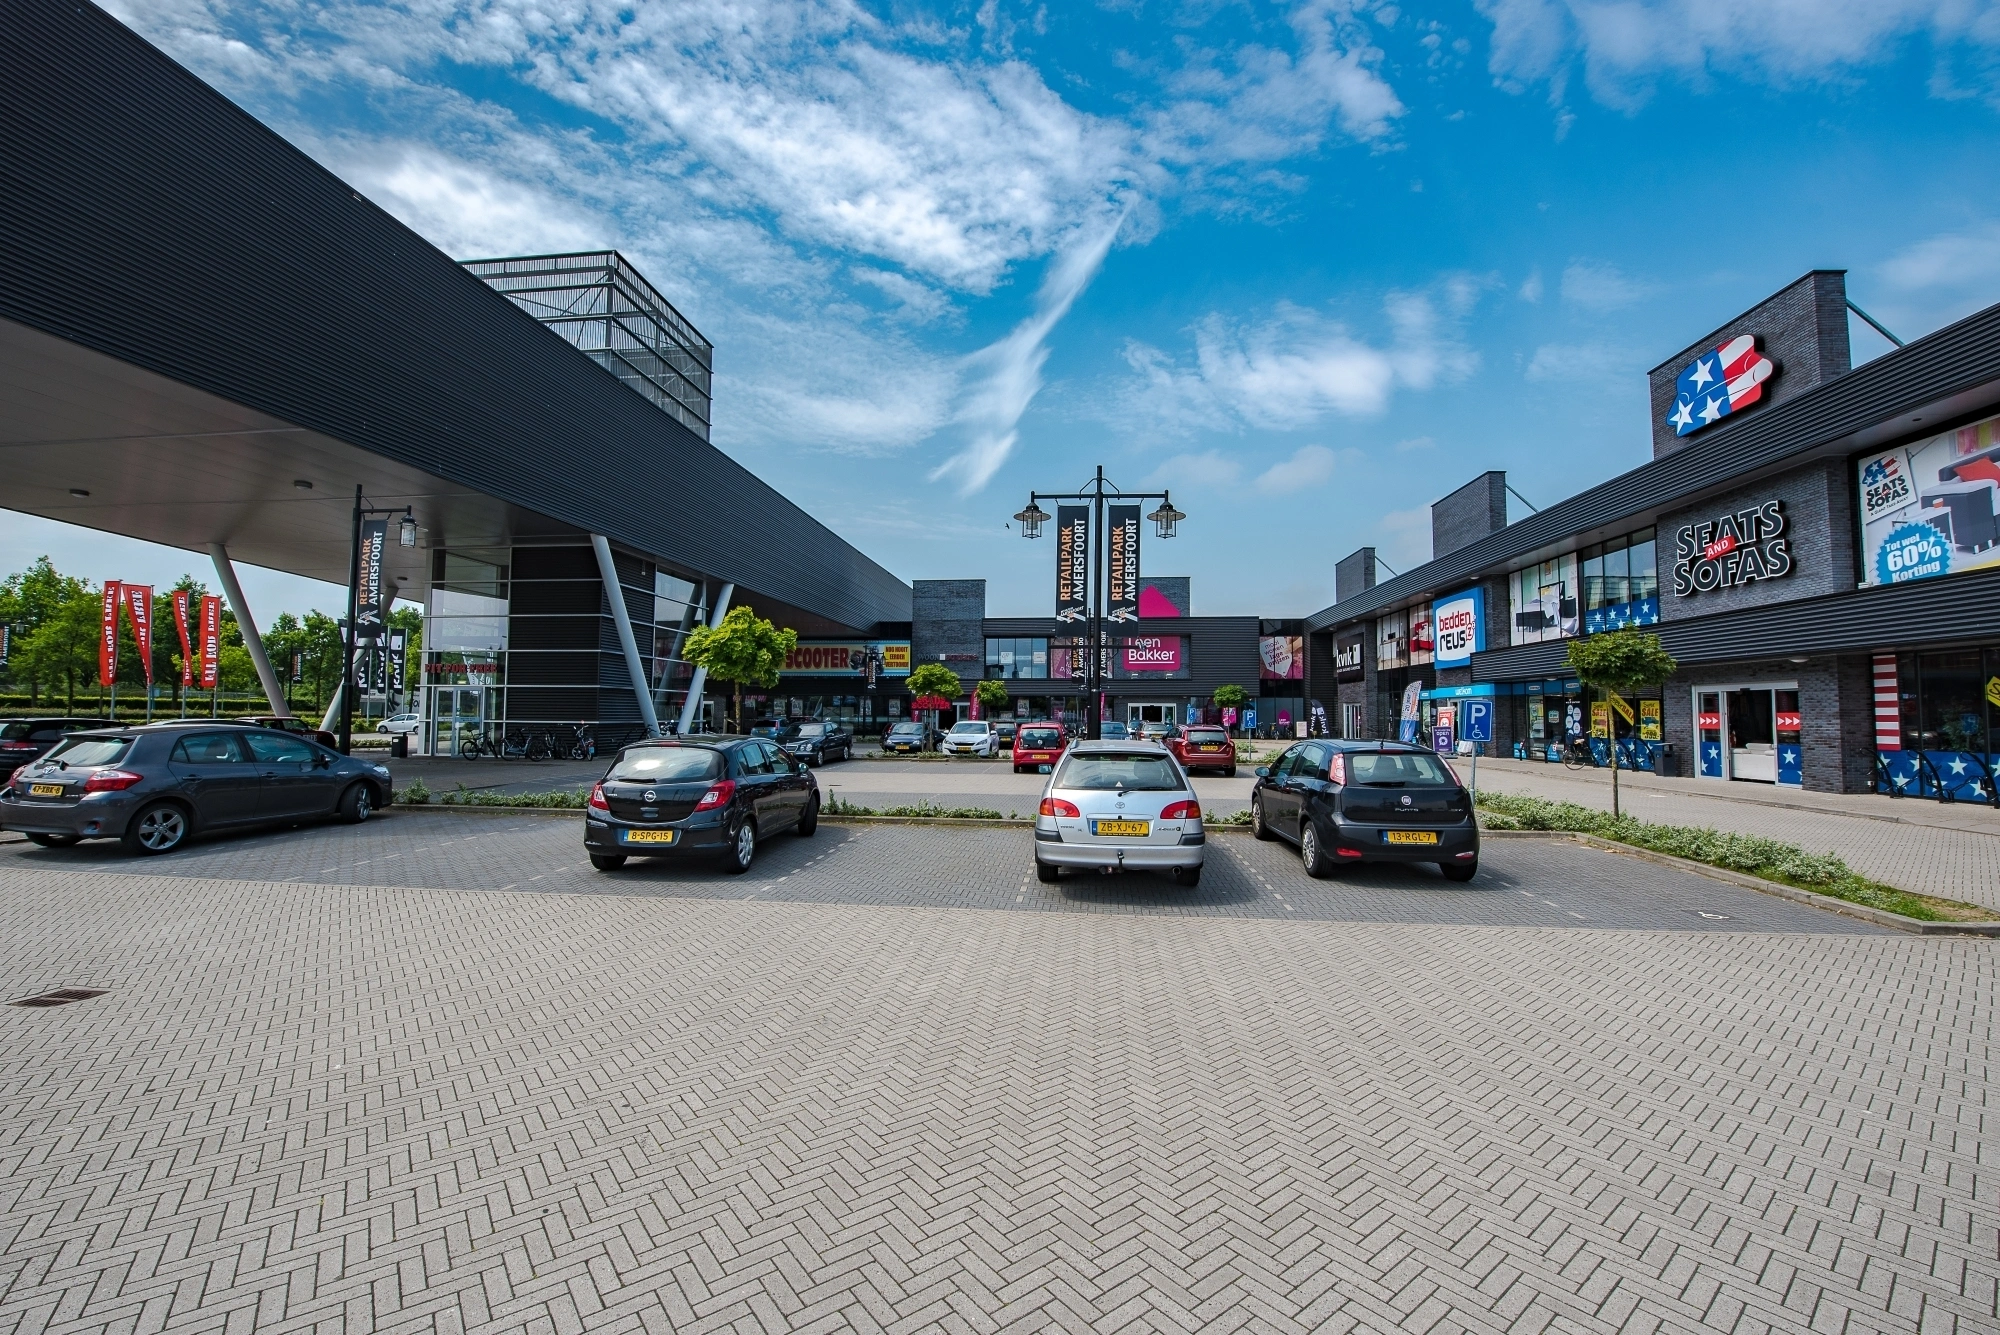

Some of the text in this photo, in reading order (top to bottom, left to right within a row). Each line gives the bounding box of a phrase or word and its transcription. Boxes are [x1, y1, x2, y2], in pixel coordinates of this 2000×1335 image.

[1866, 474, 1906, 500] SEATS
[1866, 485, 1909, 512] SOFAS
[1676, 500, 1784, 562] SEATS
[1707, 540, 1729, 558] AND
[1885, 533, 1920, 553] Tot wel
[1060, 526, 1072, 600] RETAILPARK
[1072, 518, 1086, 601] AMERSFOORT
[1112, 526, 1124, 600] RETAILPARK
[1124, 518, 1136, 601] AMERSFOORT
[1888, 537, 1942, 572] 60%
[360, 538, 372, 605] RETAILPARK
[368, 531, 382, 605] AMERSFOORT
[1673, 539, 1790, 596] SOFAS
[1892, 561, 1941, 582] Korting
[1439, 610, 1470, 632] bedden
[1440, 630, 1466, 652] reus
[786, 647, 850, 670] SCOOTER
[1128, 649, 1175, 660] Bakker
[425, 664, 442, 673] FIT
[469, 664, 497, 673] FREE
[1247, 712, 1253, 720] P
[1471, 704, 1486, 724] P
[1642, 708, 1659, 716] SALE
[32, 786, 61, 794] 47-XBK-8
[1100, 823, 1144, 832] ZB-XJ-67
[1392, 832, 1431, 841] 13-RGL-7
